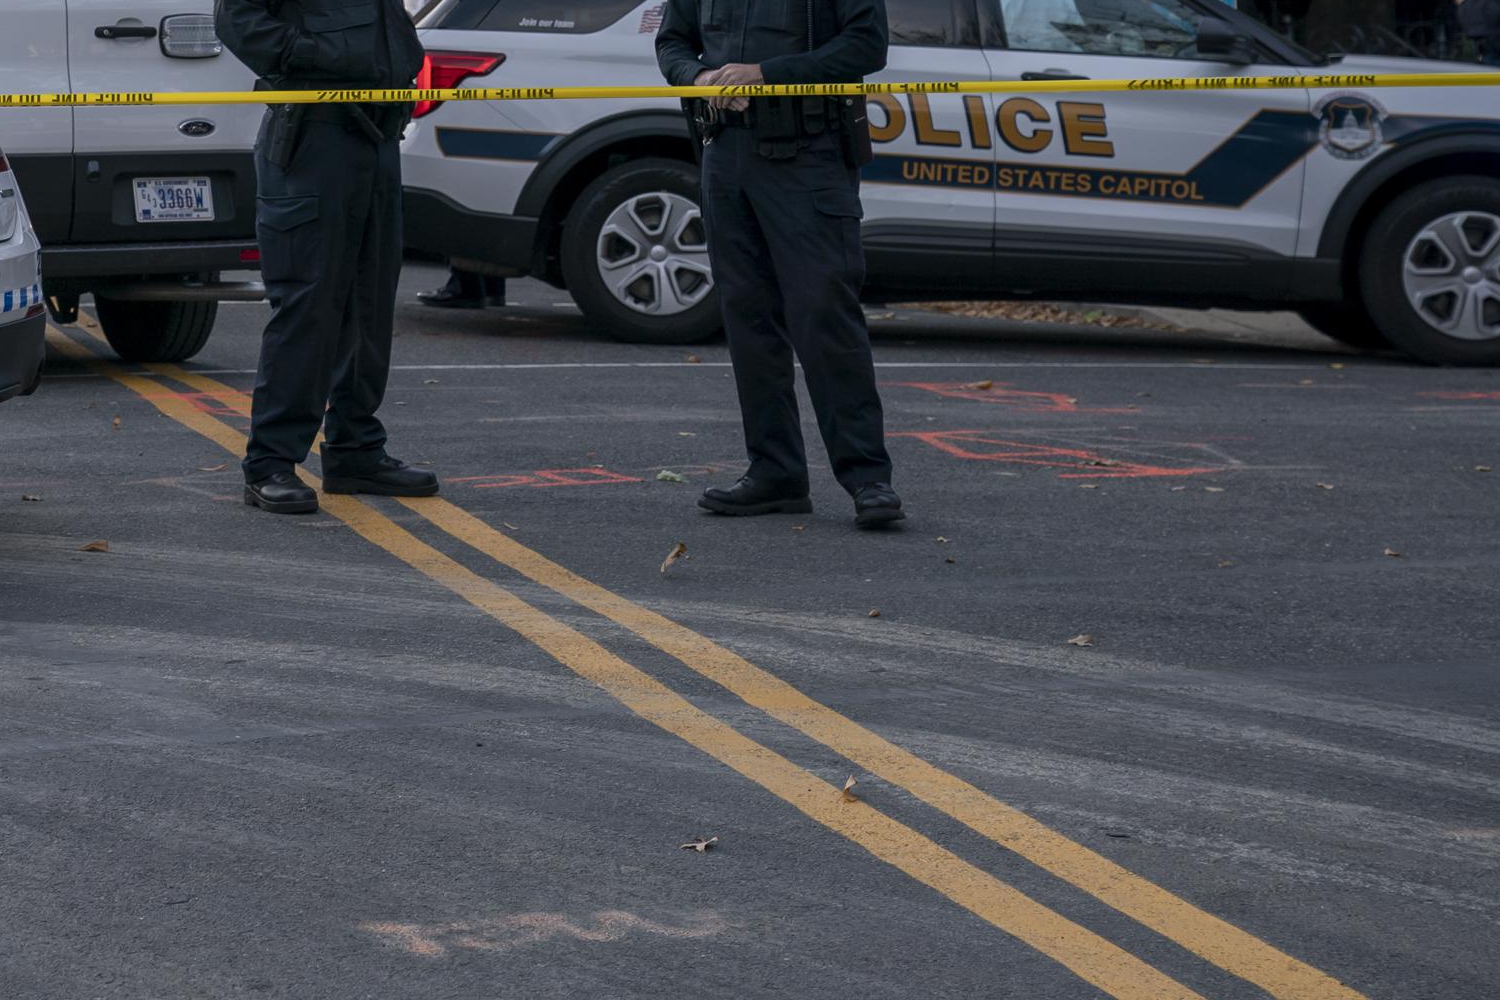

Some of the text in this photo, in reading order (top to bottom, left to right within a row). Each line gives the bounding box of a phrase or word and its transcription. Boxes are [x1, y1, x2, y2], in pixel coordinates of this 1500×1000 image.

[519, 17, 575, 29] Join our team
[867, 93, 1115, 158] OLICE
[903, 160, 1204, 200] UNITED STATES CAPITOL
[158, 187, 203, 209] 3366W
